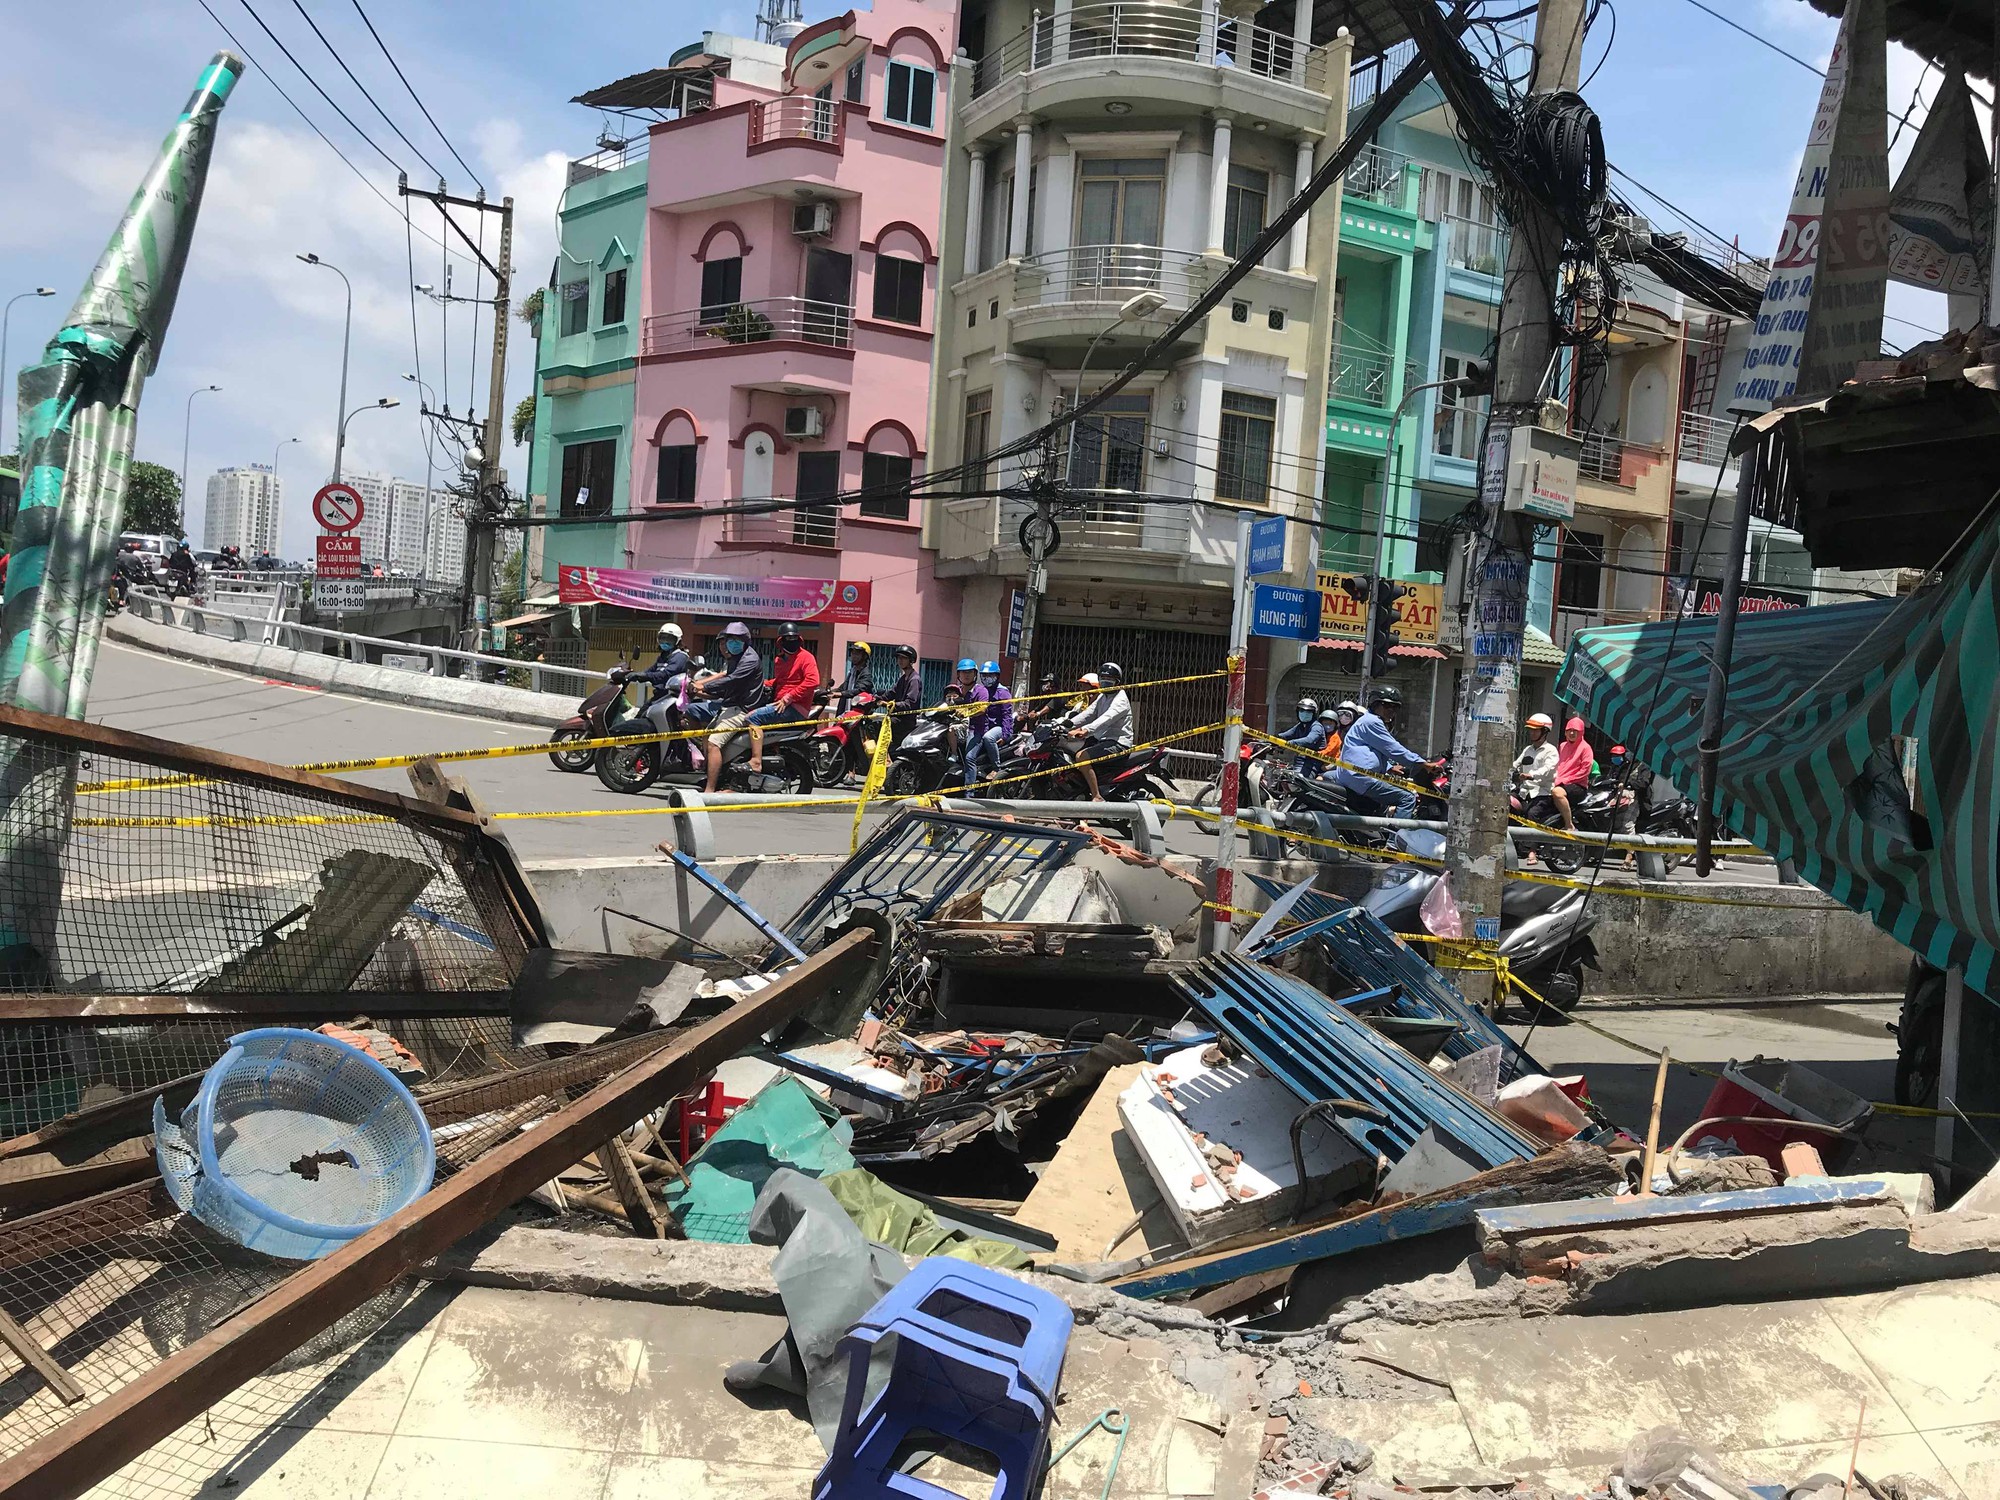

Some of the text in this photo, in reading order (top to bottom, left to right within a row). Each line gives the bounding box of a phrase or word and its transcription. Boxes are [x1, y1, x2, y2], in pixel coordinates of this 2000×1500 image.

[1272, 589, 1305, 603] ĐƯỜNG
[1259, 609, 1308, 629] HƯNG PHÚ
